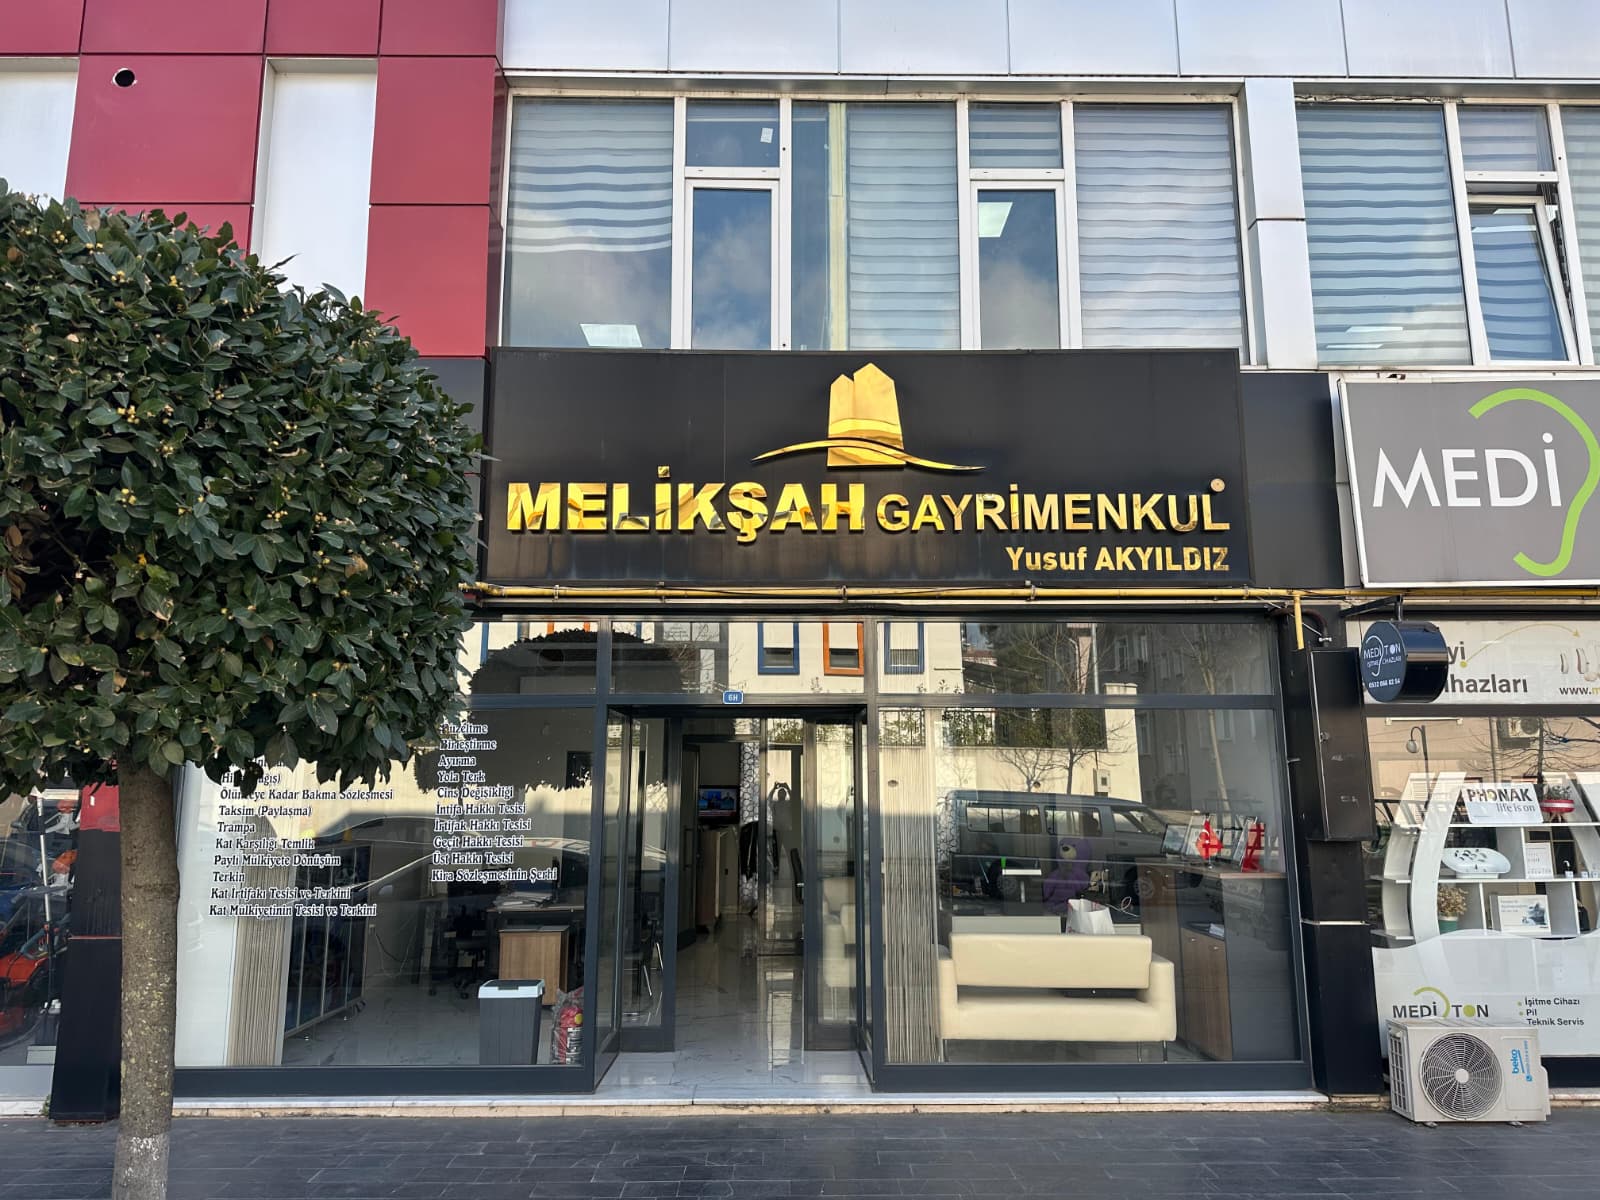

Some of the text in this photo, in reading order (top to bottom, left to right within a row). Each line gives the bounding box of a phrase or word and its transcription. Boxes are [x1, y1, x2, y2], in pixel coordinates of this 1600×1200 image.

[1373, 432, 1562, 508] MEDİ
[506, 466, 1231, 543] MELİKŞAH GAYRİMENKUL
[1005, 546, 1230, 572] Yusuf AKYILDIZ
[1444, 673, 1528, 693] hazları
[438, 754, 477, 769] Ayırma
[437, 770, 486, 783] Yola Terk
[268, 788, 299, 800] Kadar
[302, 788, 337, 800] Bakma
[339, 788, 393, 802] Sözleşmesi
[437, 784, 514, 800] Cins Değişikliği
[1467, 788, 1533, 802] PHONAK
[218, 805, 312, 818] Taksim (Paylaşma)
[435, 802, 526, 818] İntifa Hakkı Tesisi
[1496, 802, 1536, 812] life is on
[217, 821, 256, 834] Trampa
[433, 818, 532, 834] İrtifak Hakkı Tesisi
[215, 838, 316, 852] Kat Karşılığı Temlik
[433, 835, 524, 851] Geçit Hakkı Tesisi
[214, 854, 342, 869] Paylı Mülkiyete Dönüşüm
[432, 850, 514, 865] Üst Hakkı Tesisi
[212, 871, 246, 883] Terkin
[431, 867, 558, 884] Kira Sözleşmesinin Şerhi
[210, 885, 351, 902] Kat İrtifakı Tesisi ve Terkini
[208, 903, 377, 919] Kat Mülkiyetinin Tesisi ve Terkini
[1525, 997, 1580, 1007] İşitme Cihazı
[1526, 1008, 1538, 1016] Pil
[1527, 1018, 1585, 1026] Teknik Servis
[1510, 1049, 1520, 1074] beko
